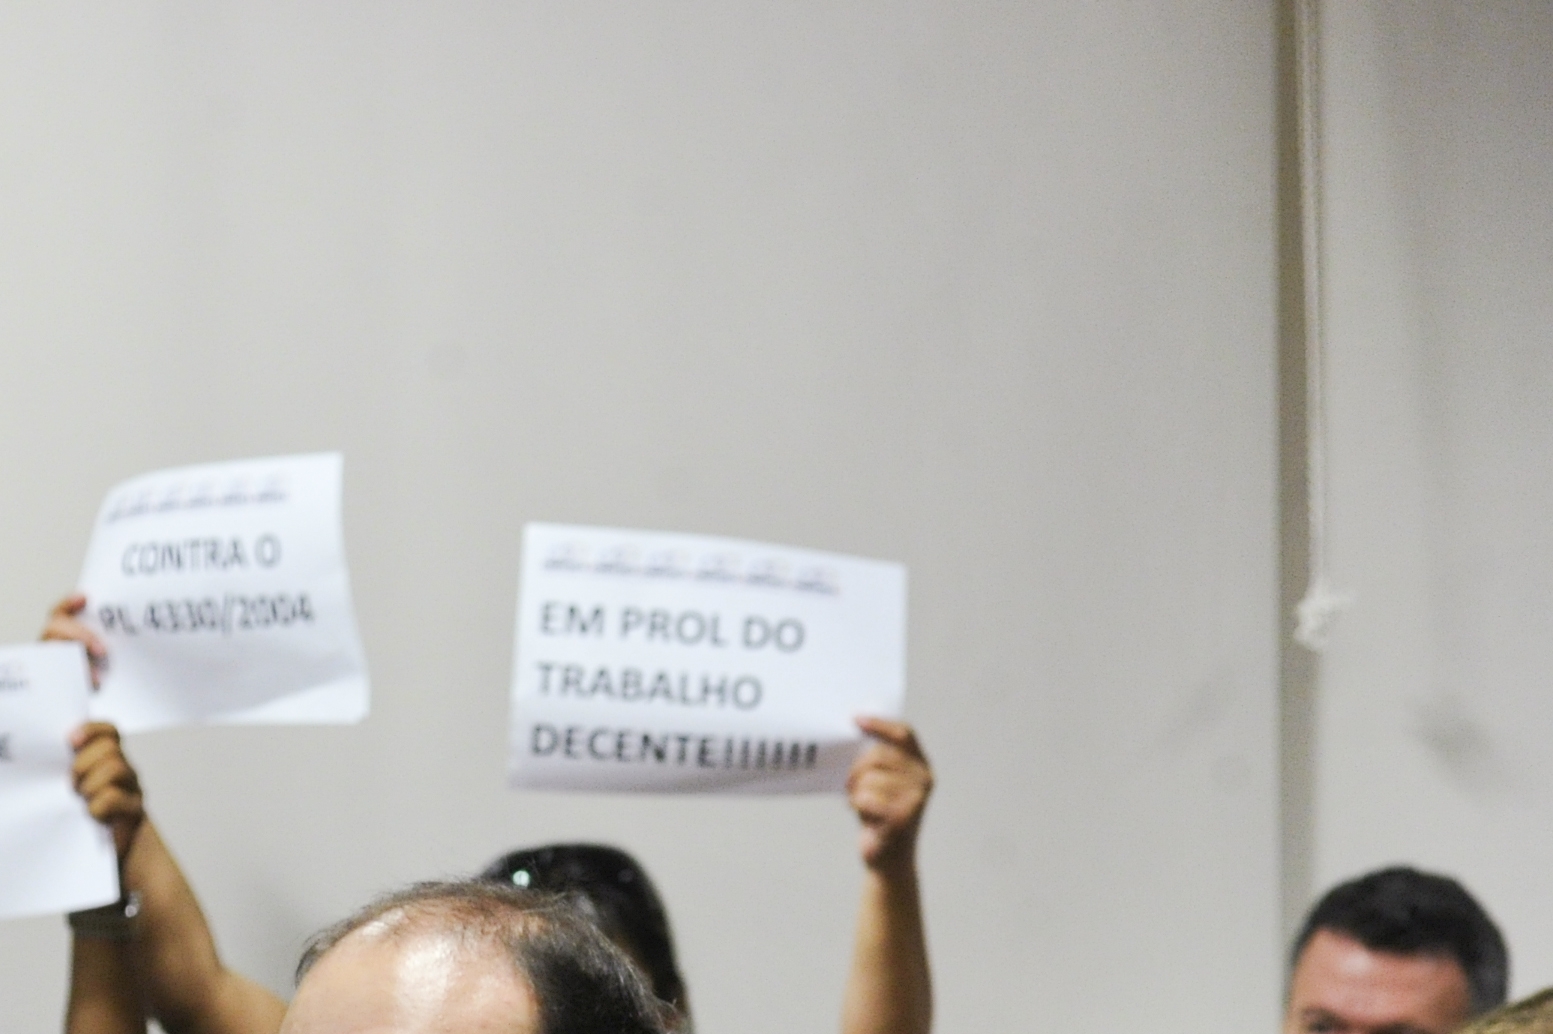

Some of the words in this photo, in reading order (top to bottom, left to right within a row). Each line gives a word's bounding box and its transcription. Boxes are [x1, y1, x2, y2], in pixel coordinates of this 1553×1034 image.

[120, 536, 247, 577] CONTRA
[254, 531, 282, 569] O
[98, 604, 138, 636] PL
[144, 590, 315, 638] 4330/2004
[539, 600, 606, 639] EM
[618, 605, 728, 649] PROL
[742, 615, 806, 654] DO
[535, 661, 764, 711] TRABALHO
